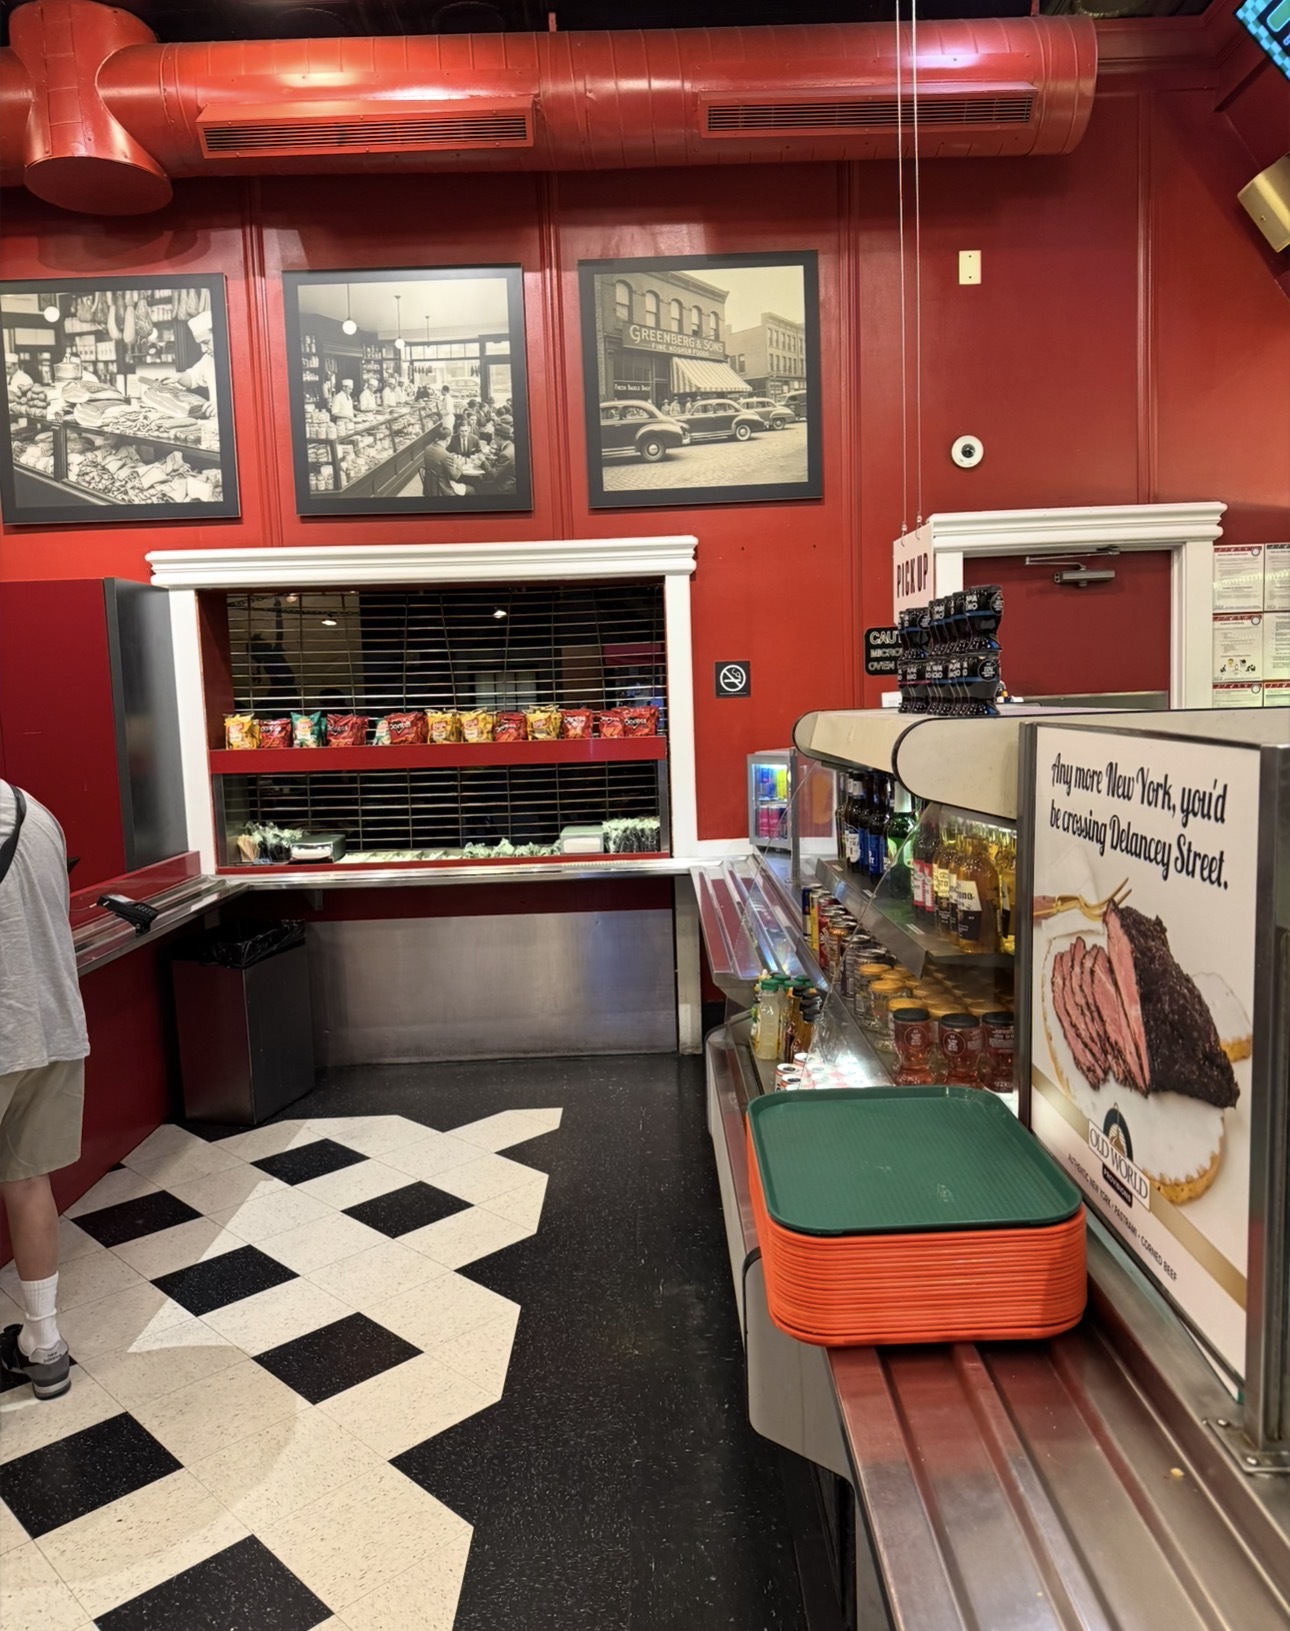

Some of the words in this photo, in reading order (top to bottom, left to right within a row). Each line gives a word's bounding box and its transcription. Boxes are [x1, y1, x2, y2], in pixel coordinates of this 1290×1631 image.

[629, 324, 695, 348] GREENBERG
[695, 340, 702, 349] &
[703, 339, 723, 353] SONS
[897, 558, 915, 598] PICK
[917, 552, 928, 592] UP
[869, 630, 901, 645] CAUT
[870, 647, 902, 658] MICRO
[868, 661, 895, 671] OVEN
[1051, 752, 1073, 796] Any
[1074, 766, 1103, 794] more
[1106, 761, 1134, 801] New
[1137, 766, 1176, 818] York,
[1180, 778, 1228, 828] you'd
[1050, 799, 1062, 829] be
[1062, 810, 1107, 856] crossing
[1109, 815, 1172, 881] Delancey
[1174, 833, 1228, 890] Street.
[1090, 1128, 1110, 1159] OLD
[1110, 1149, 1149, 1200] WORLD
[1089, 1177, 1099, 1194] NEW
[1114, 1205, 1137, 1238] PASTRAMI
[1140, 1235, 1163, 1266] CORNED
[1163, 1261, 1178, 1282] BEEF
